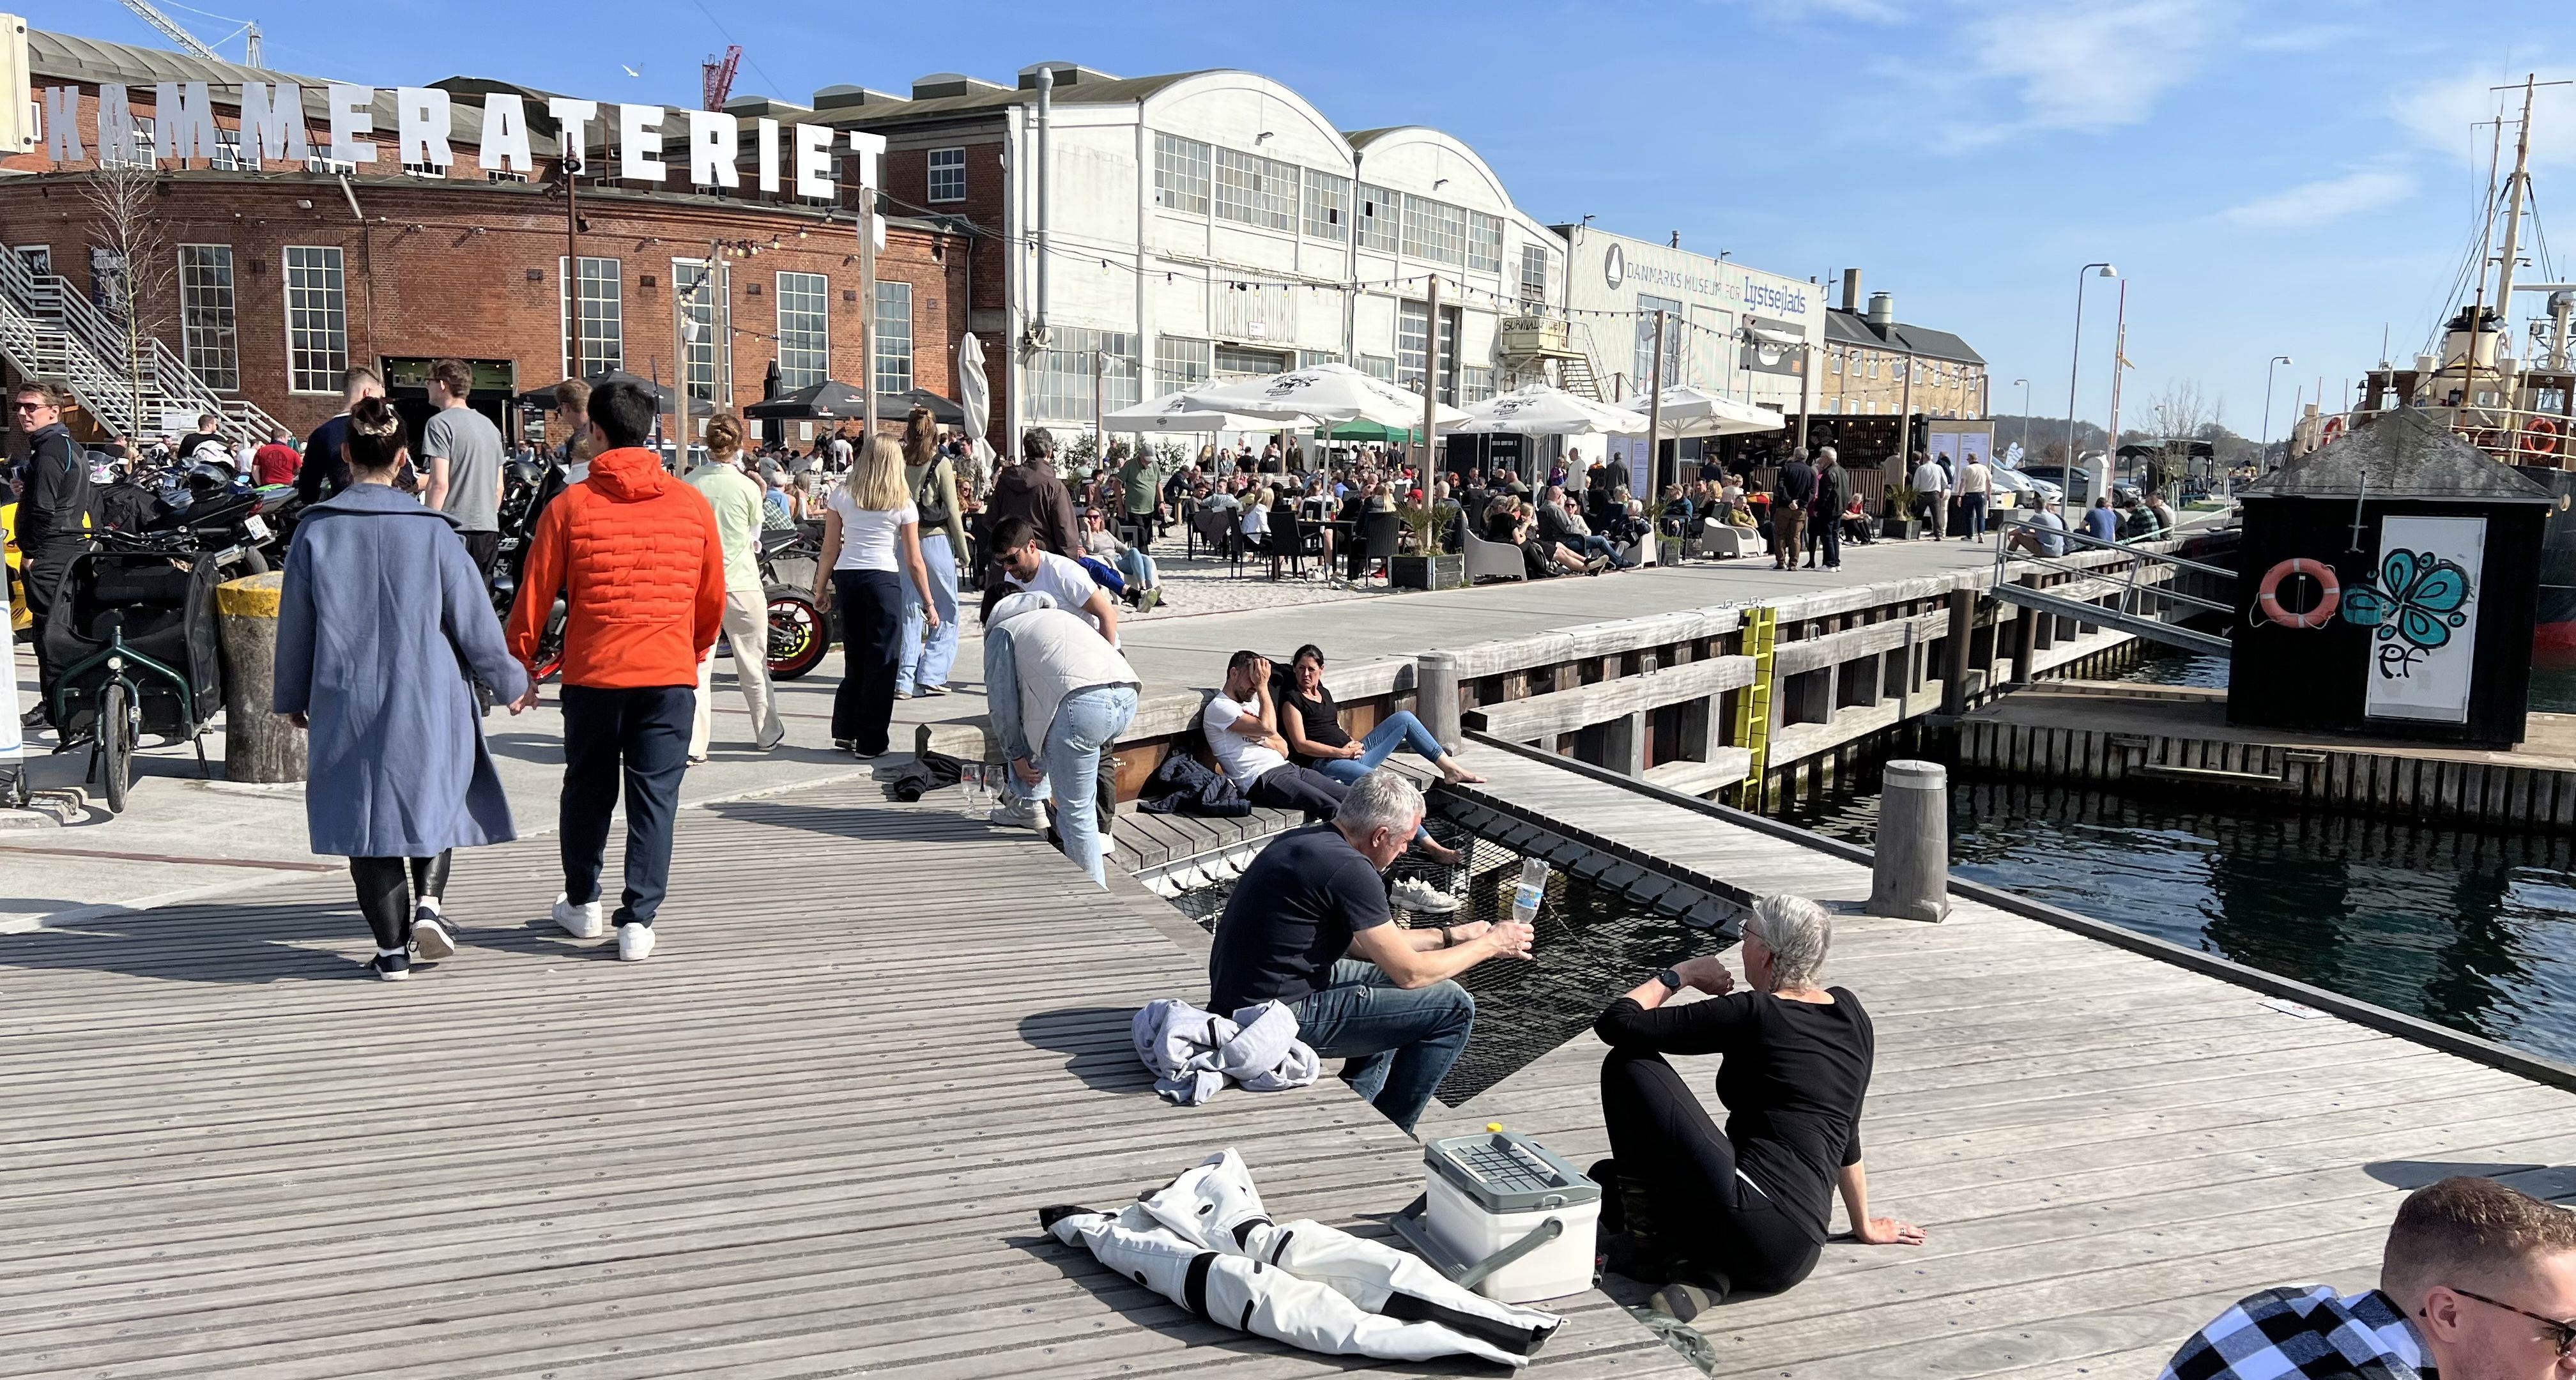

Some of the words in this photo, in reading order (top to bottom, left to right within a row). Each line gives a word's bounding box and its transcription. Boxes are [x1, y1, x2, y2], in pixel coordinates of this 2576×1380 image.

[45, 81, 887, 203] KAMMERATERIET
[1627, 261, 1682, 288] DANMARKS
[1685, 275, 1722, 296] MUSEUM
[1725, 284, 1740, 301] FOR
[1744, 275, 1806, 316] Lystsejlads
[1504, 319, 1539, 331] SURVIVAL
